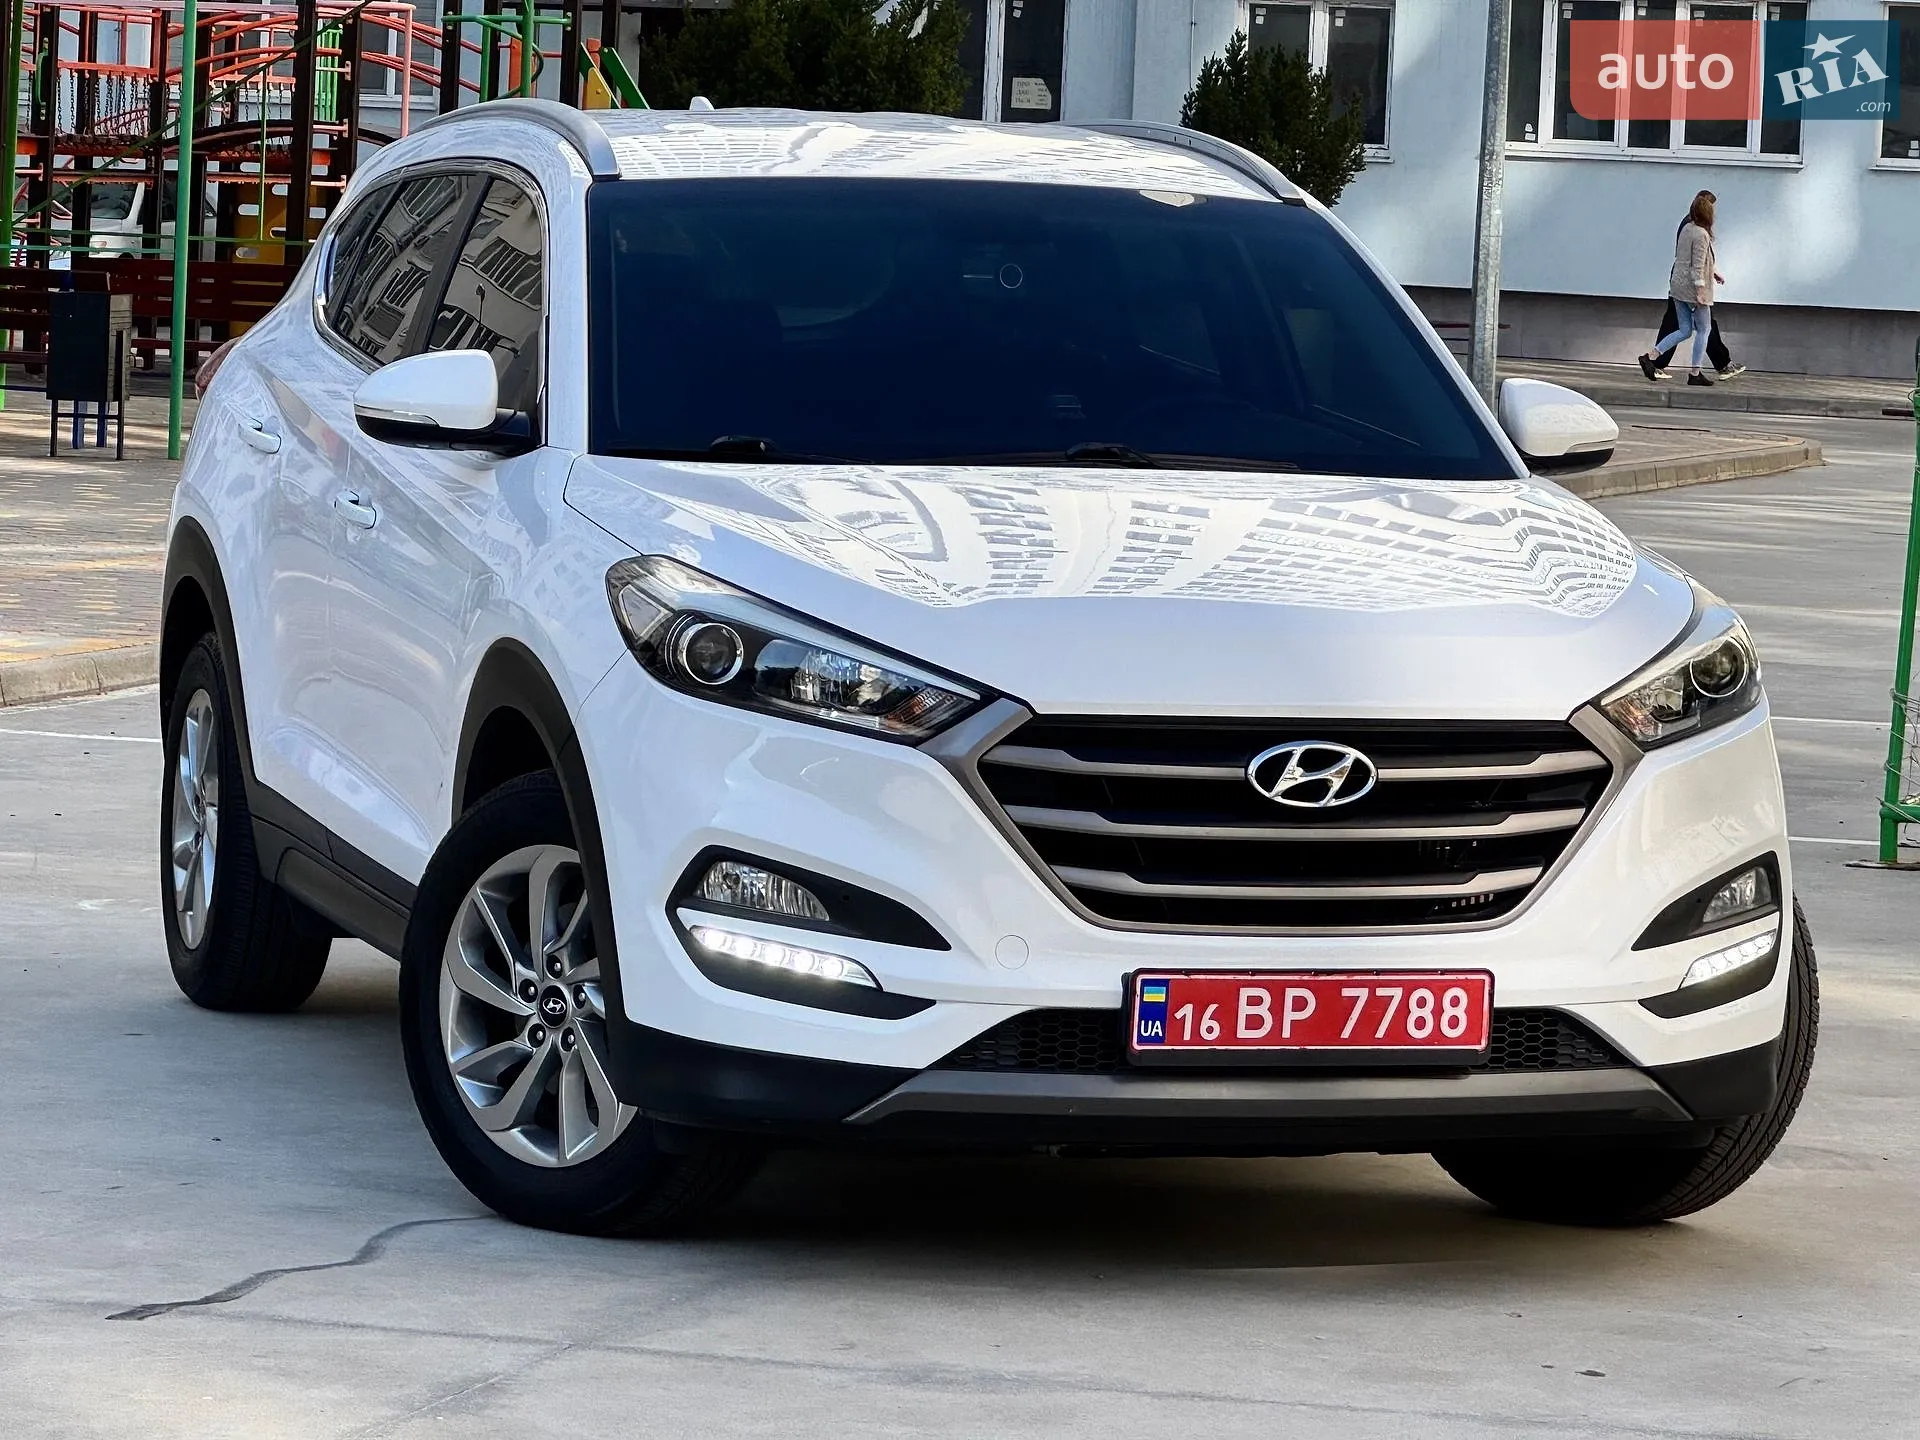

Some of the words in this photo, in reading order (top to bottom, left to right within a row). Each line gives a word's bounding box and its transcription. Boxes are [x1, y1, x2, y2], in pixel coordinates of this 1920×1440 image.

[1140, 1020, 1163, 1037] UA
[1174, 1003, 1221, 1041] 16
[1236, 987, 1316, 1039] BP
[1340, 987, 1468, 1039] 7788
